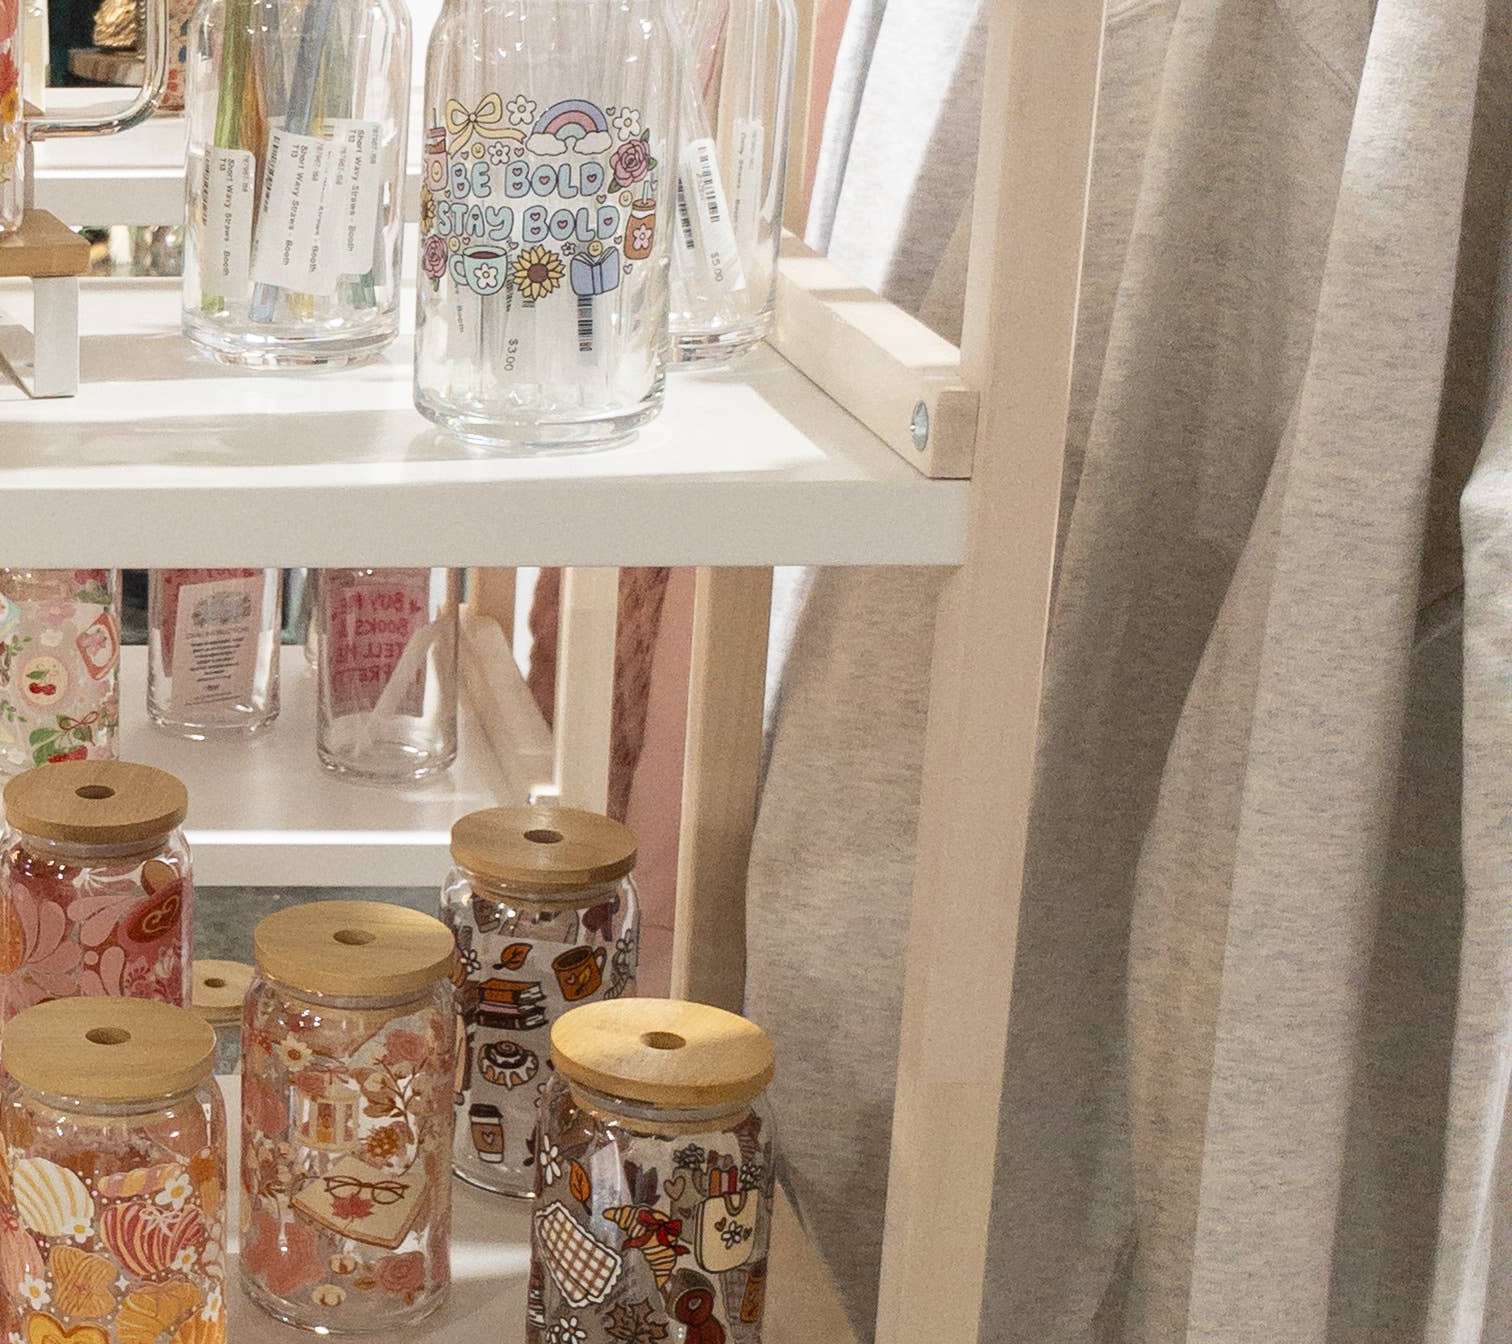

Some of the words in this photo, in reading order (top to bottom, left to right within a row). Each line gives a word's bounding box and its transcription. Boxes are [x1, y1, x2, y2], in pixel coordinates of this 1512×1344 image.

[451, 161, 492, 199] BE
[504, 160, 605, 199] BOLD
[437, 200, 514, 242] STAY
[522, 205, 620, 243] BOLD
[504, 338, 518, 372] $3.00
